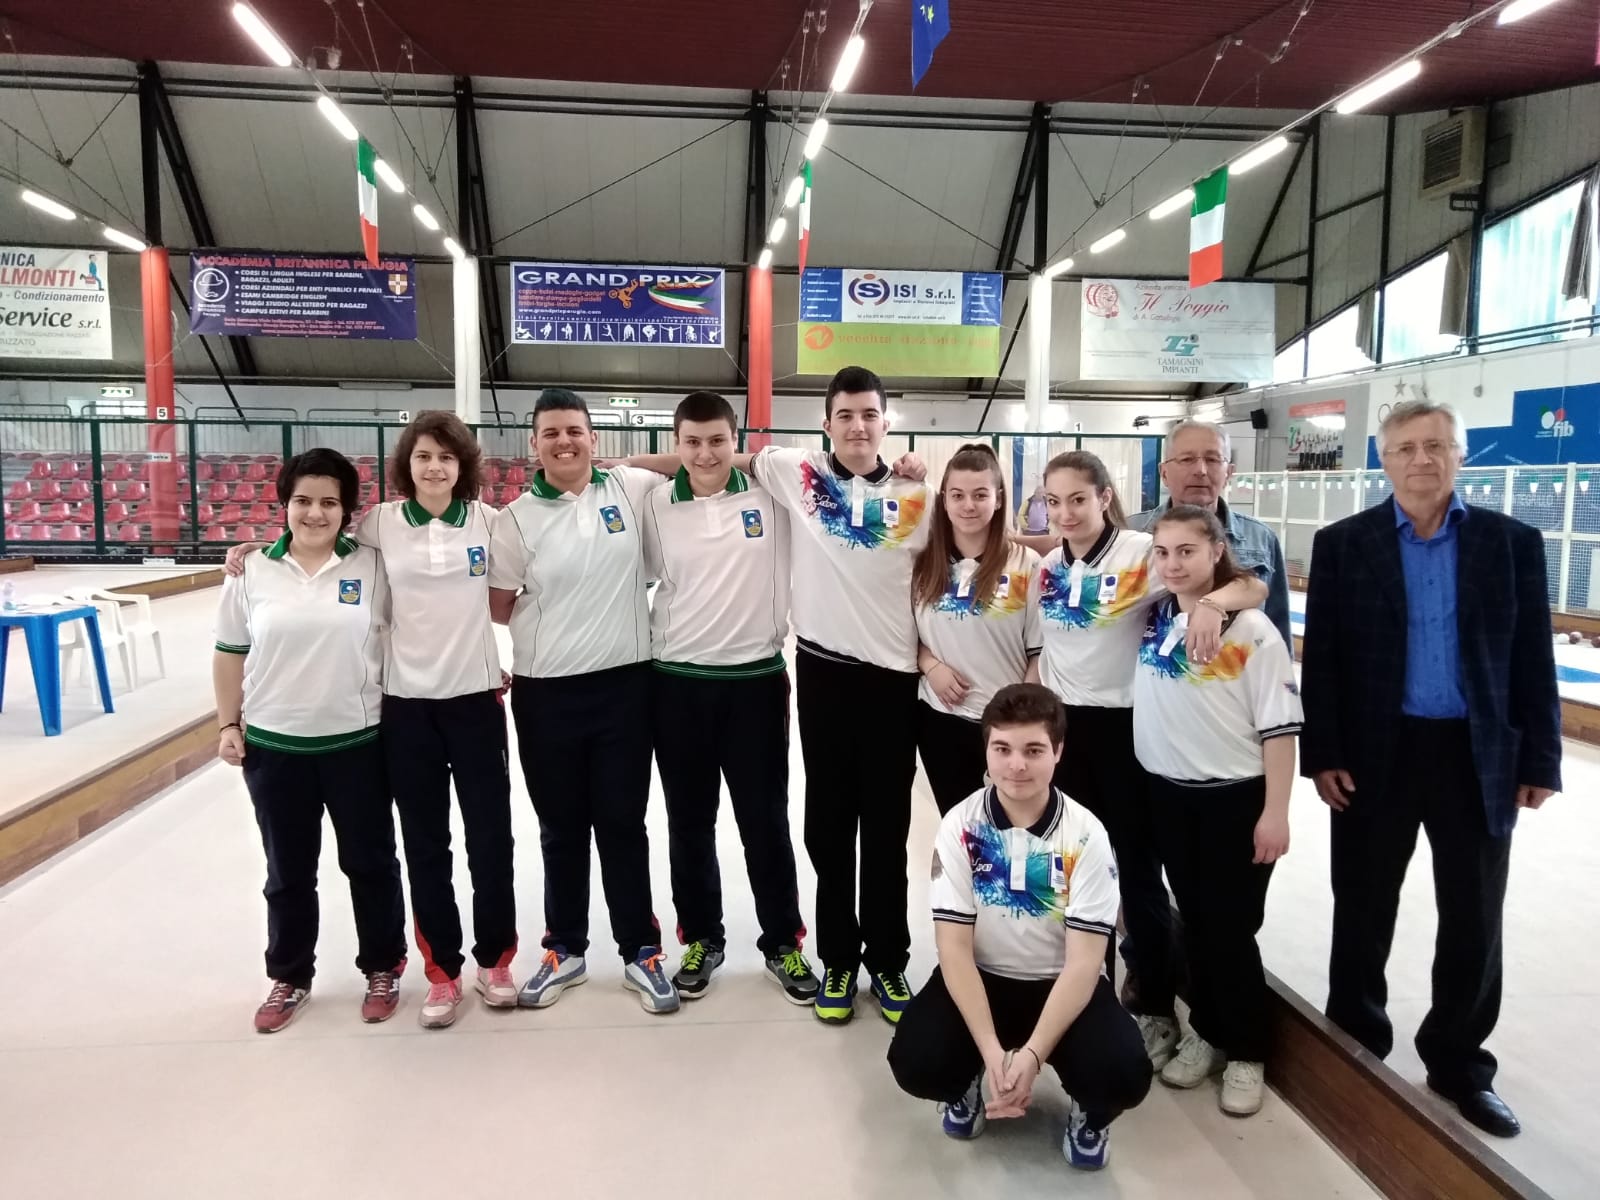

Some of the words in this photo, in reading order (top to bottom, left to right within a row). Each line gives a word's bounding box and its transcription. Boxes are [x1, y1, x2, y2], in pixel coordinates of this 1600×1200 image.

[198, 256, 272, 267] ACCADEMIA
[275, 258, 350, 269] BRITANNICA
[354, 260, 409, 272] PEUGIA
[518, 271, 628, 286] GRAND
[639, 274, 701, 288] PRIX
[14, 290, 105, 303] Condizionamento
[894, 284, 916, 298] ISI
[925, 288, 956, 299] S.r.l.
[78, 319, 102, 329] s.r.l.
[158, 409, 166, 418] 5
[401, 413, 407, 422] 4
[637, 416, 644, 424] 3
[1076, 423, 1081, 432] 1
[1554, 420, 1574, 437] fib
